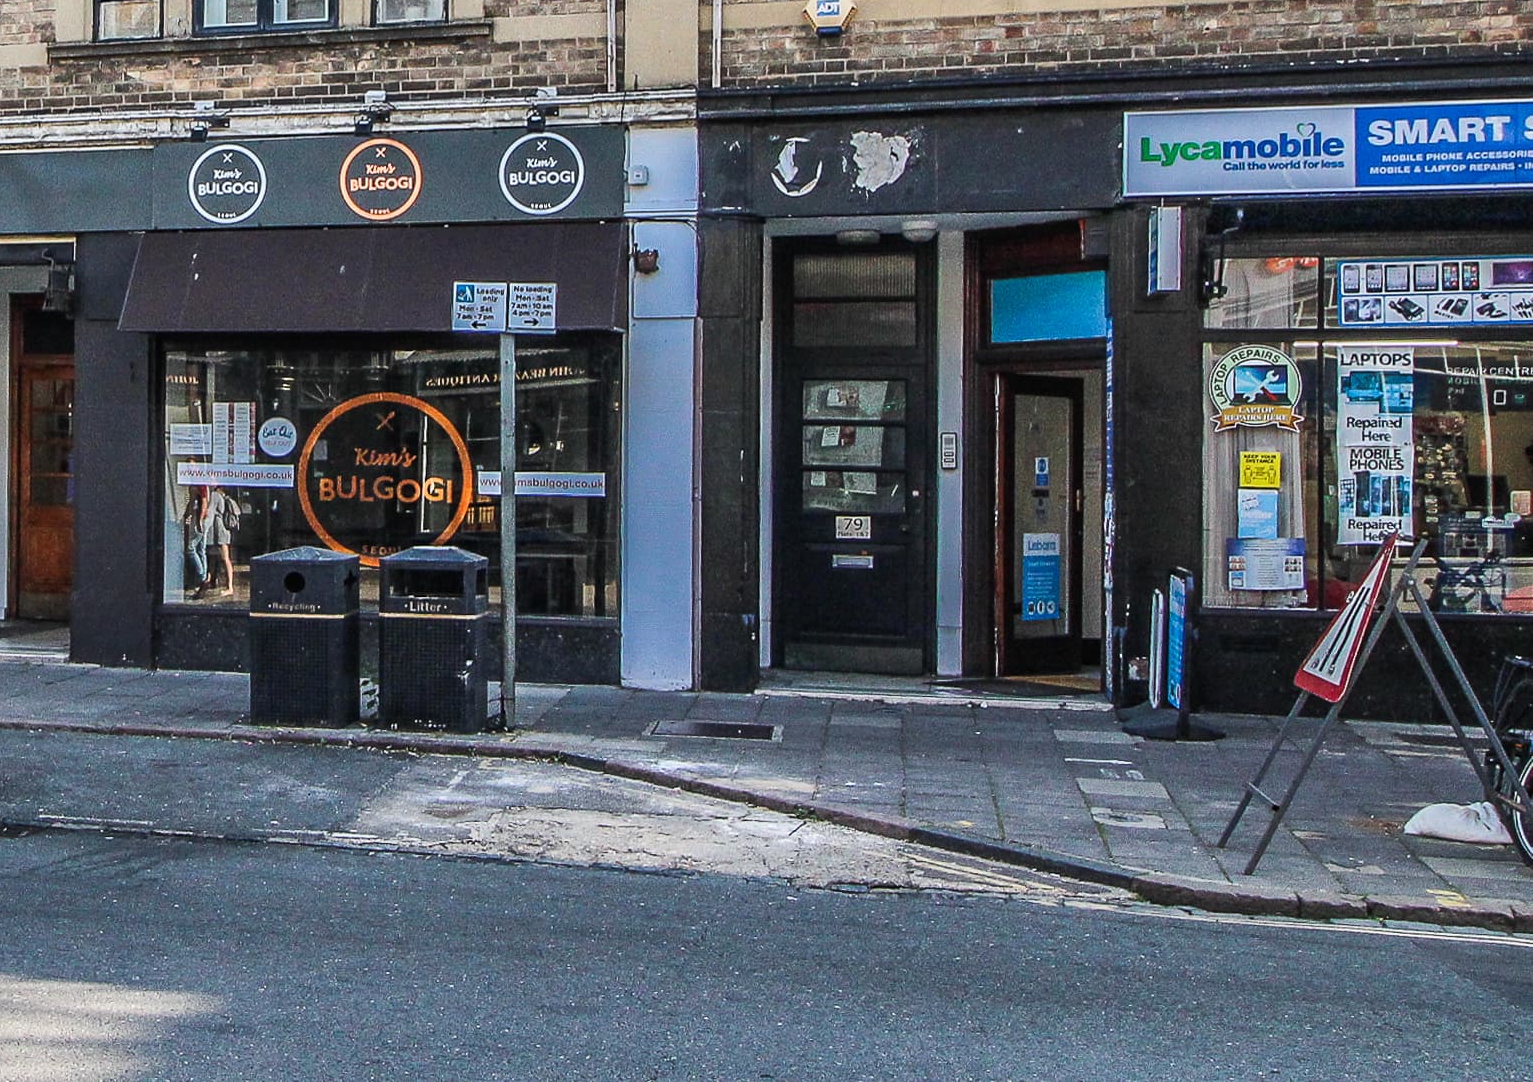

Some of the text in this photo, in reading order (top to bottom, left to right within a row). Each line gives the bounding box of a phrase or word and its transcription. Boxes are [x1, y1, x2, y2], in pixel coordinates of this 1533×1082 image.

[817, 3, 840, 14] ADT
[1368, 116, 1511, 146] SMART
[1140, 132, 1345, 166] Lycamobile
[526, 156, 558, 168] Kim's
[1382, 153, 1423, 163] MOBILE
[1426, 152, 1463, 161] PHONE
[366, 163, 396, 174] Kim's
[1223, 160, 1345, 171] Call the world for less
[1370, 165, 1411, 174] MOBILE
[1414, 165, 1422, 173] &
[1424, 164, 1466, 173] LAPTOP
[1469, 162, 1515, 171] REPAIRS
[214, 168, 242, 179] Kim's
[509, 170, 575, 185] BULGOGI
[198, 181, 258, 196] BULGOGI
[350, 176, 413, 191] BULGOGI
[1230, 349, 1281, 364] REPAIRS
[1340, 353, 1412, 367] LAPTOPS
[1214, 363, 1228, 405] LAPTOP
[1347, 417, 1403, 430] Repaired
[1361, 430, 1392, 442] Here
[354, 446, 416, 467] Kim's
[1350, 449, 1401, 460] MOBILE
[1349, 459, 1405, 471] PHONES
[318, 475, 454, 504] BULGOGI
[843, 518, 863, 530] 79
[1348, 519, 1402, 532] Repaired
[273, 603, 316, 613] Recycling
[409, 601, 442, 612] Litter
